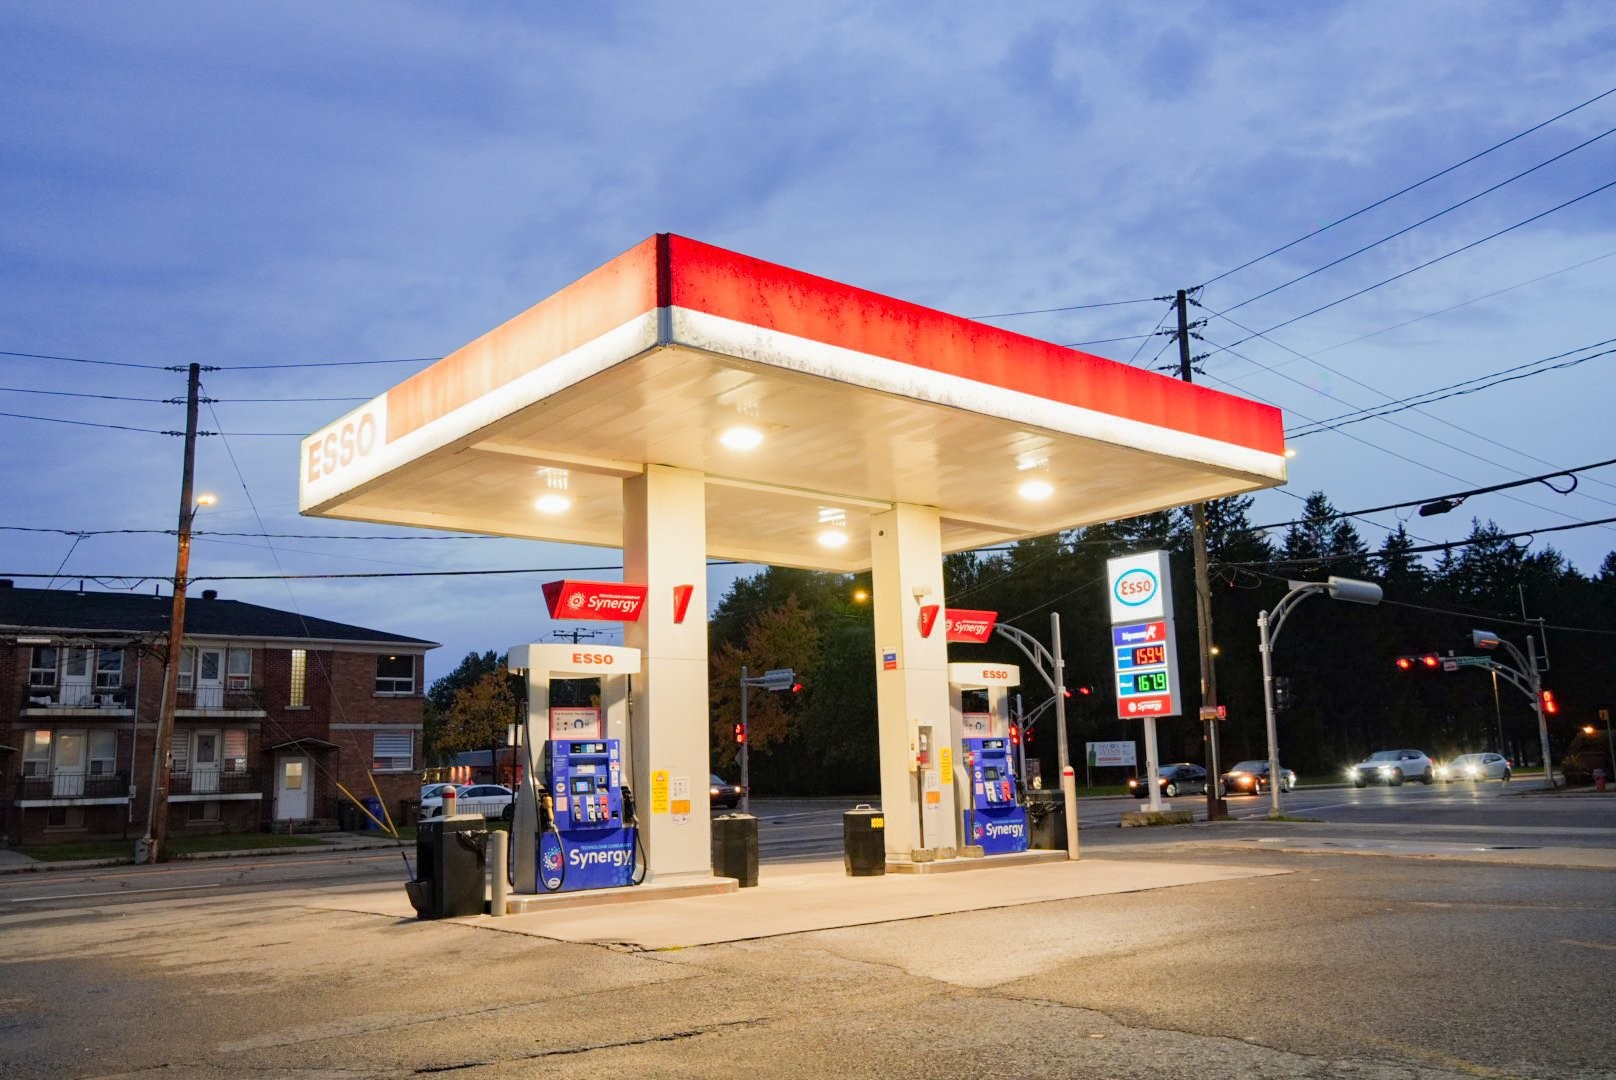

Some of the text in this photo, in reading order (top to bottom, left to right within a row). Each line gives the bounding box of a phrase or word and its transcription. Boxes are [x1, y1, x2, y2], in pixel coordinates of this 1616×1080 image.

[308, 412, 376, 483] ESSO
[588, 595, 639, 613] Synergy
[922, 613, 928, 623] 3
[954, 621, 988, 635] Synergy
[572, 653, 614, 665] ESSO
[983, 670, 1008, 679] ESSO
[986, 823, 1024, 839] Synergy
[570, 848, 632, 870] Synergy
